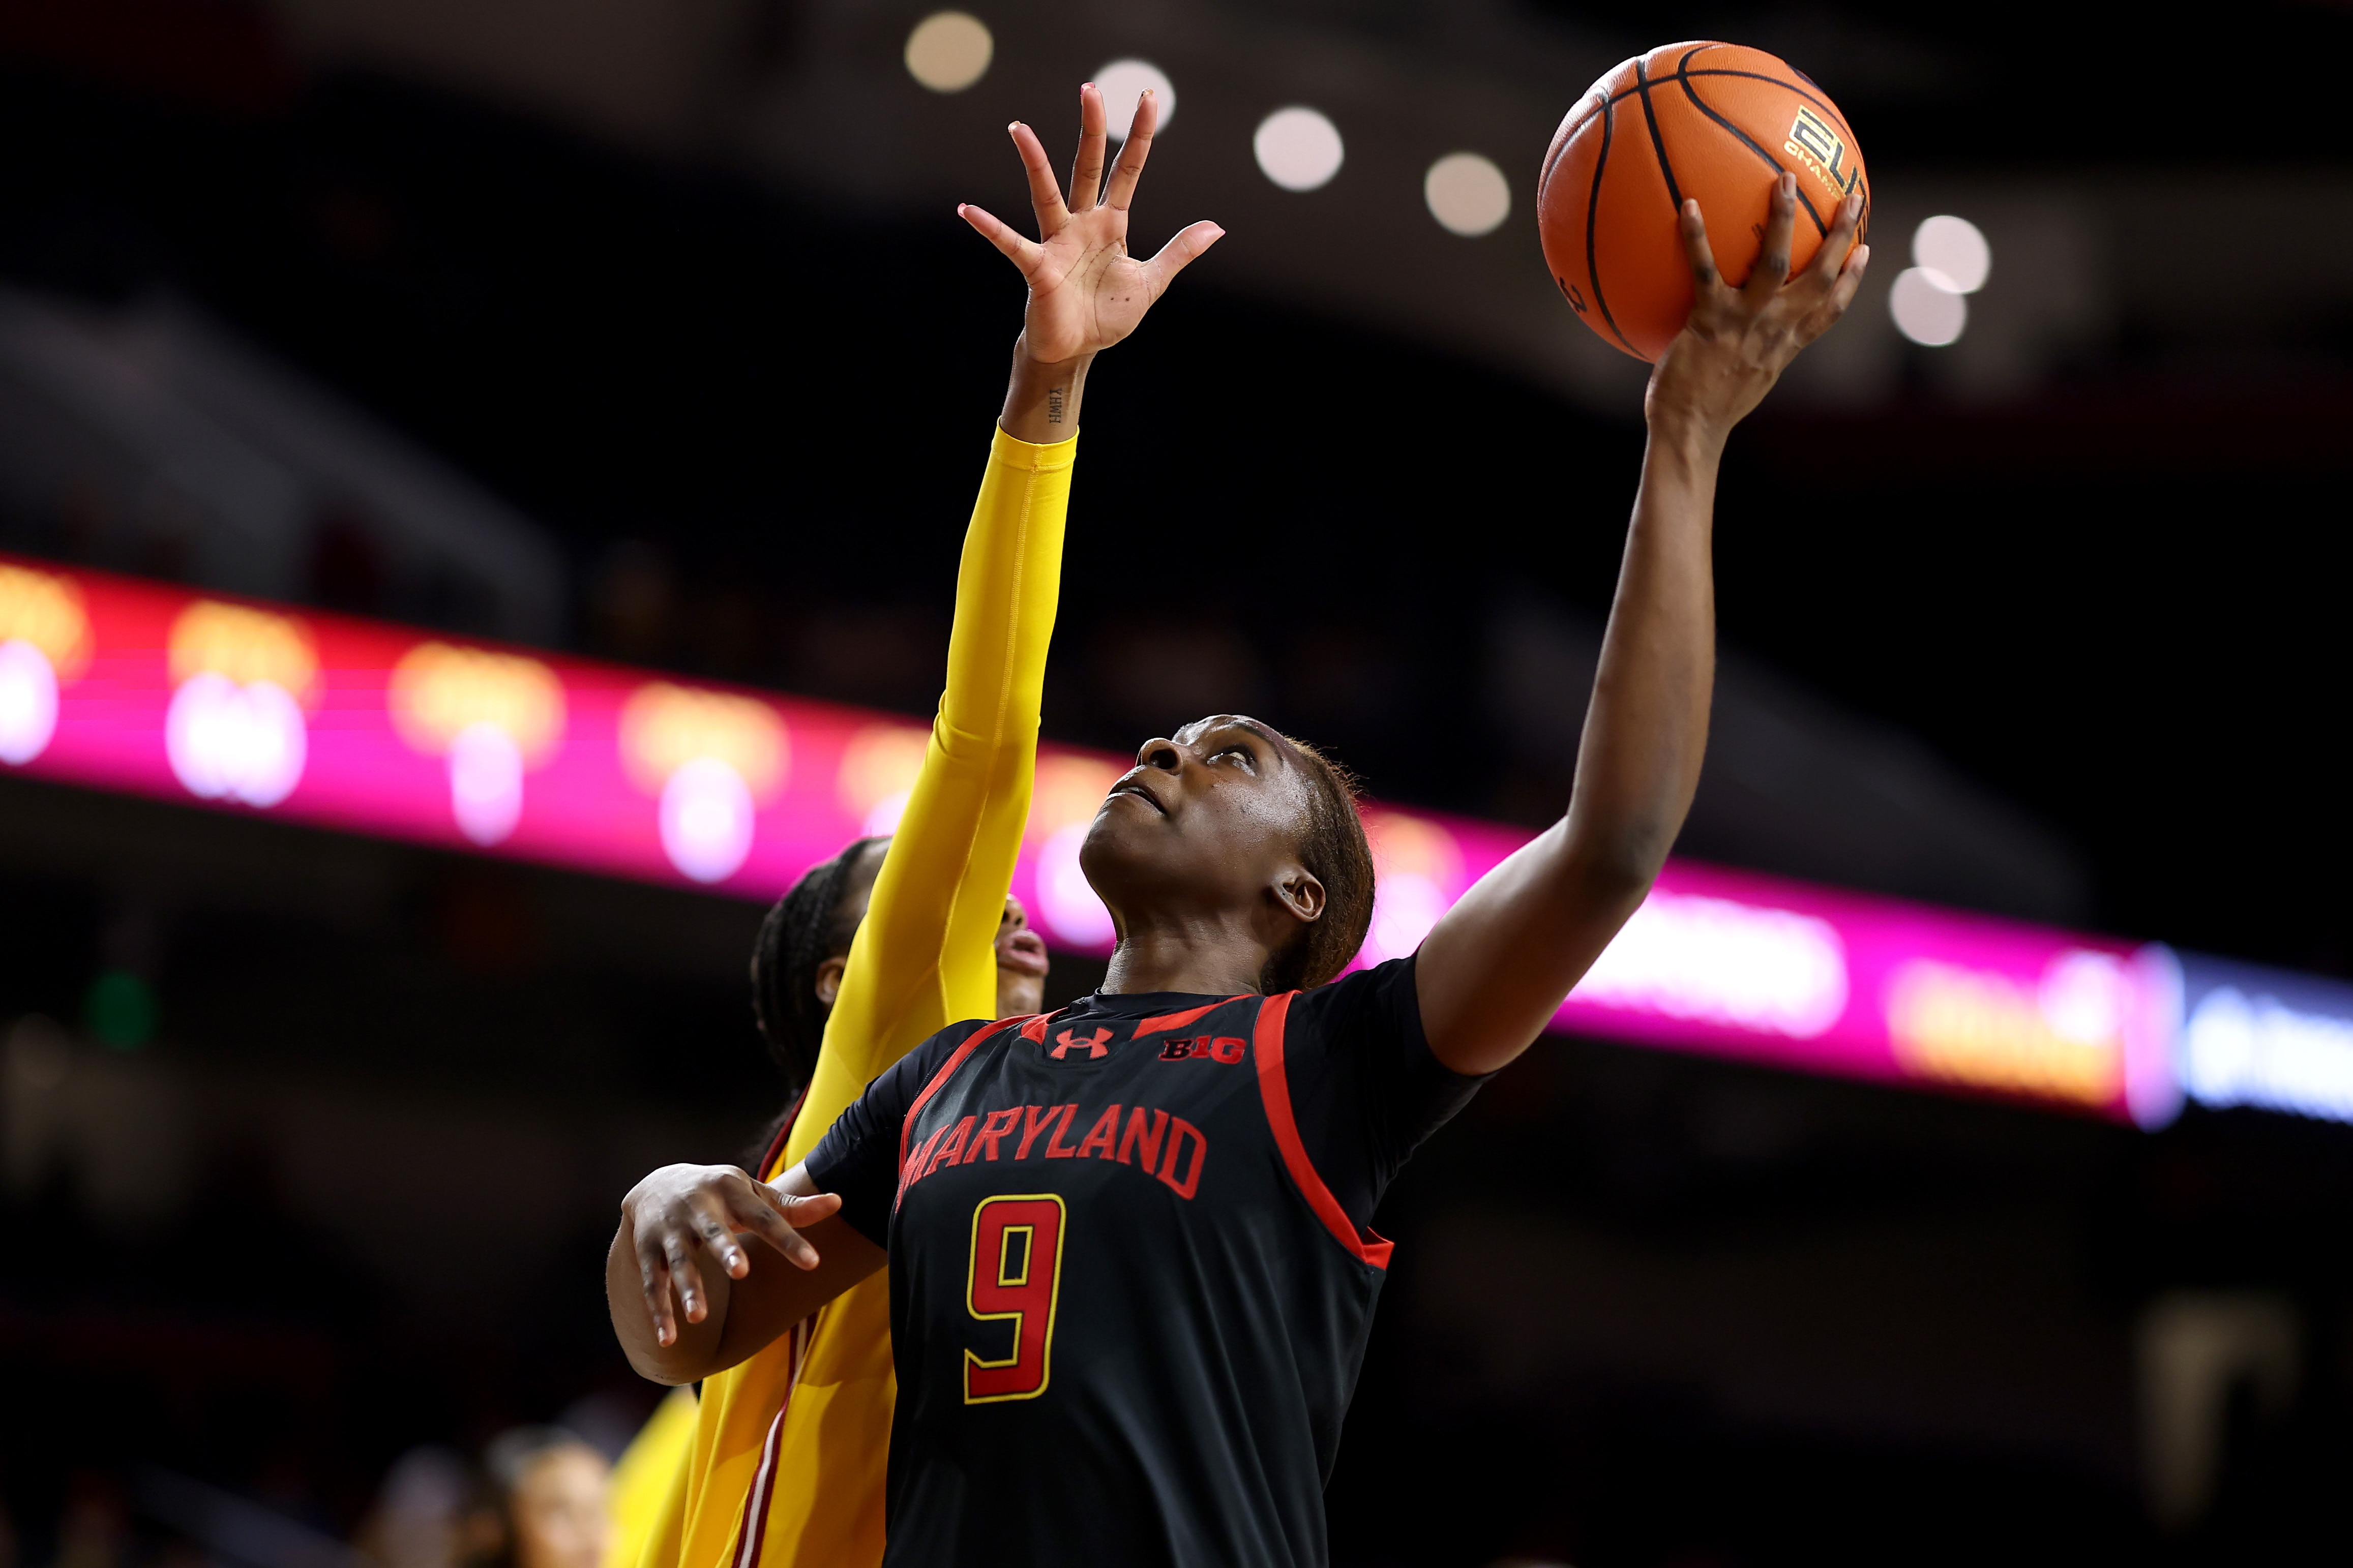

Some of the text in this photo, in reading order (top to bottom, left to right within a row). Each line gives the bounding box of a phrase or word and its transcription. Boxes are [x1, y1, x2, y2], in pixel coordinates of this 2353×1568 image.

[1049, 387, 1063, 424] YHWH
[895, 1103, 1207, 1214] MARYLAND
[964, 1193, 1066, 1405] 9
